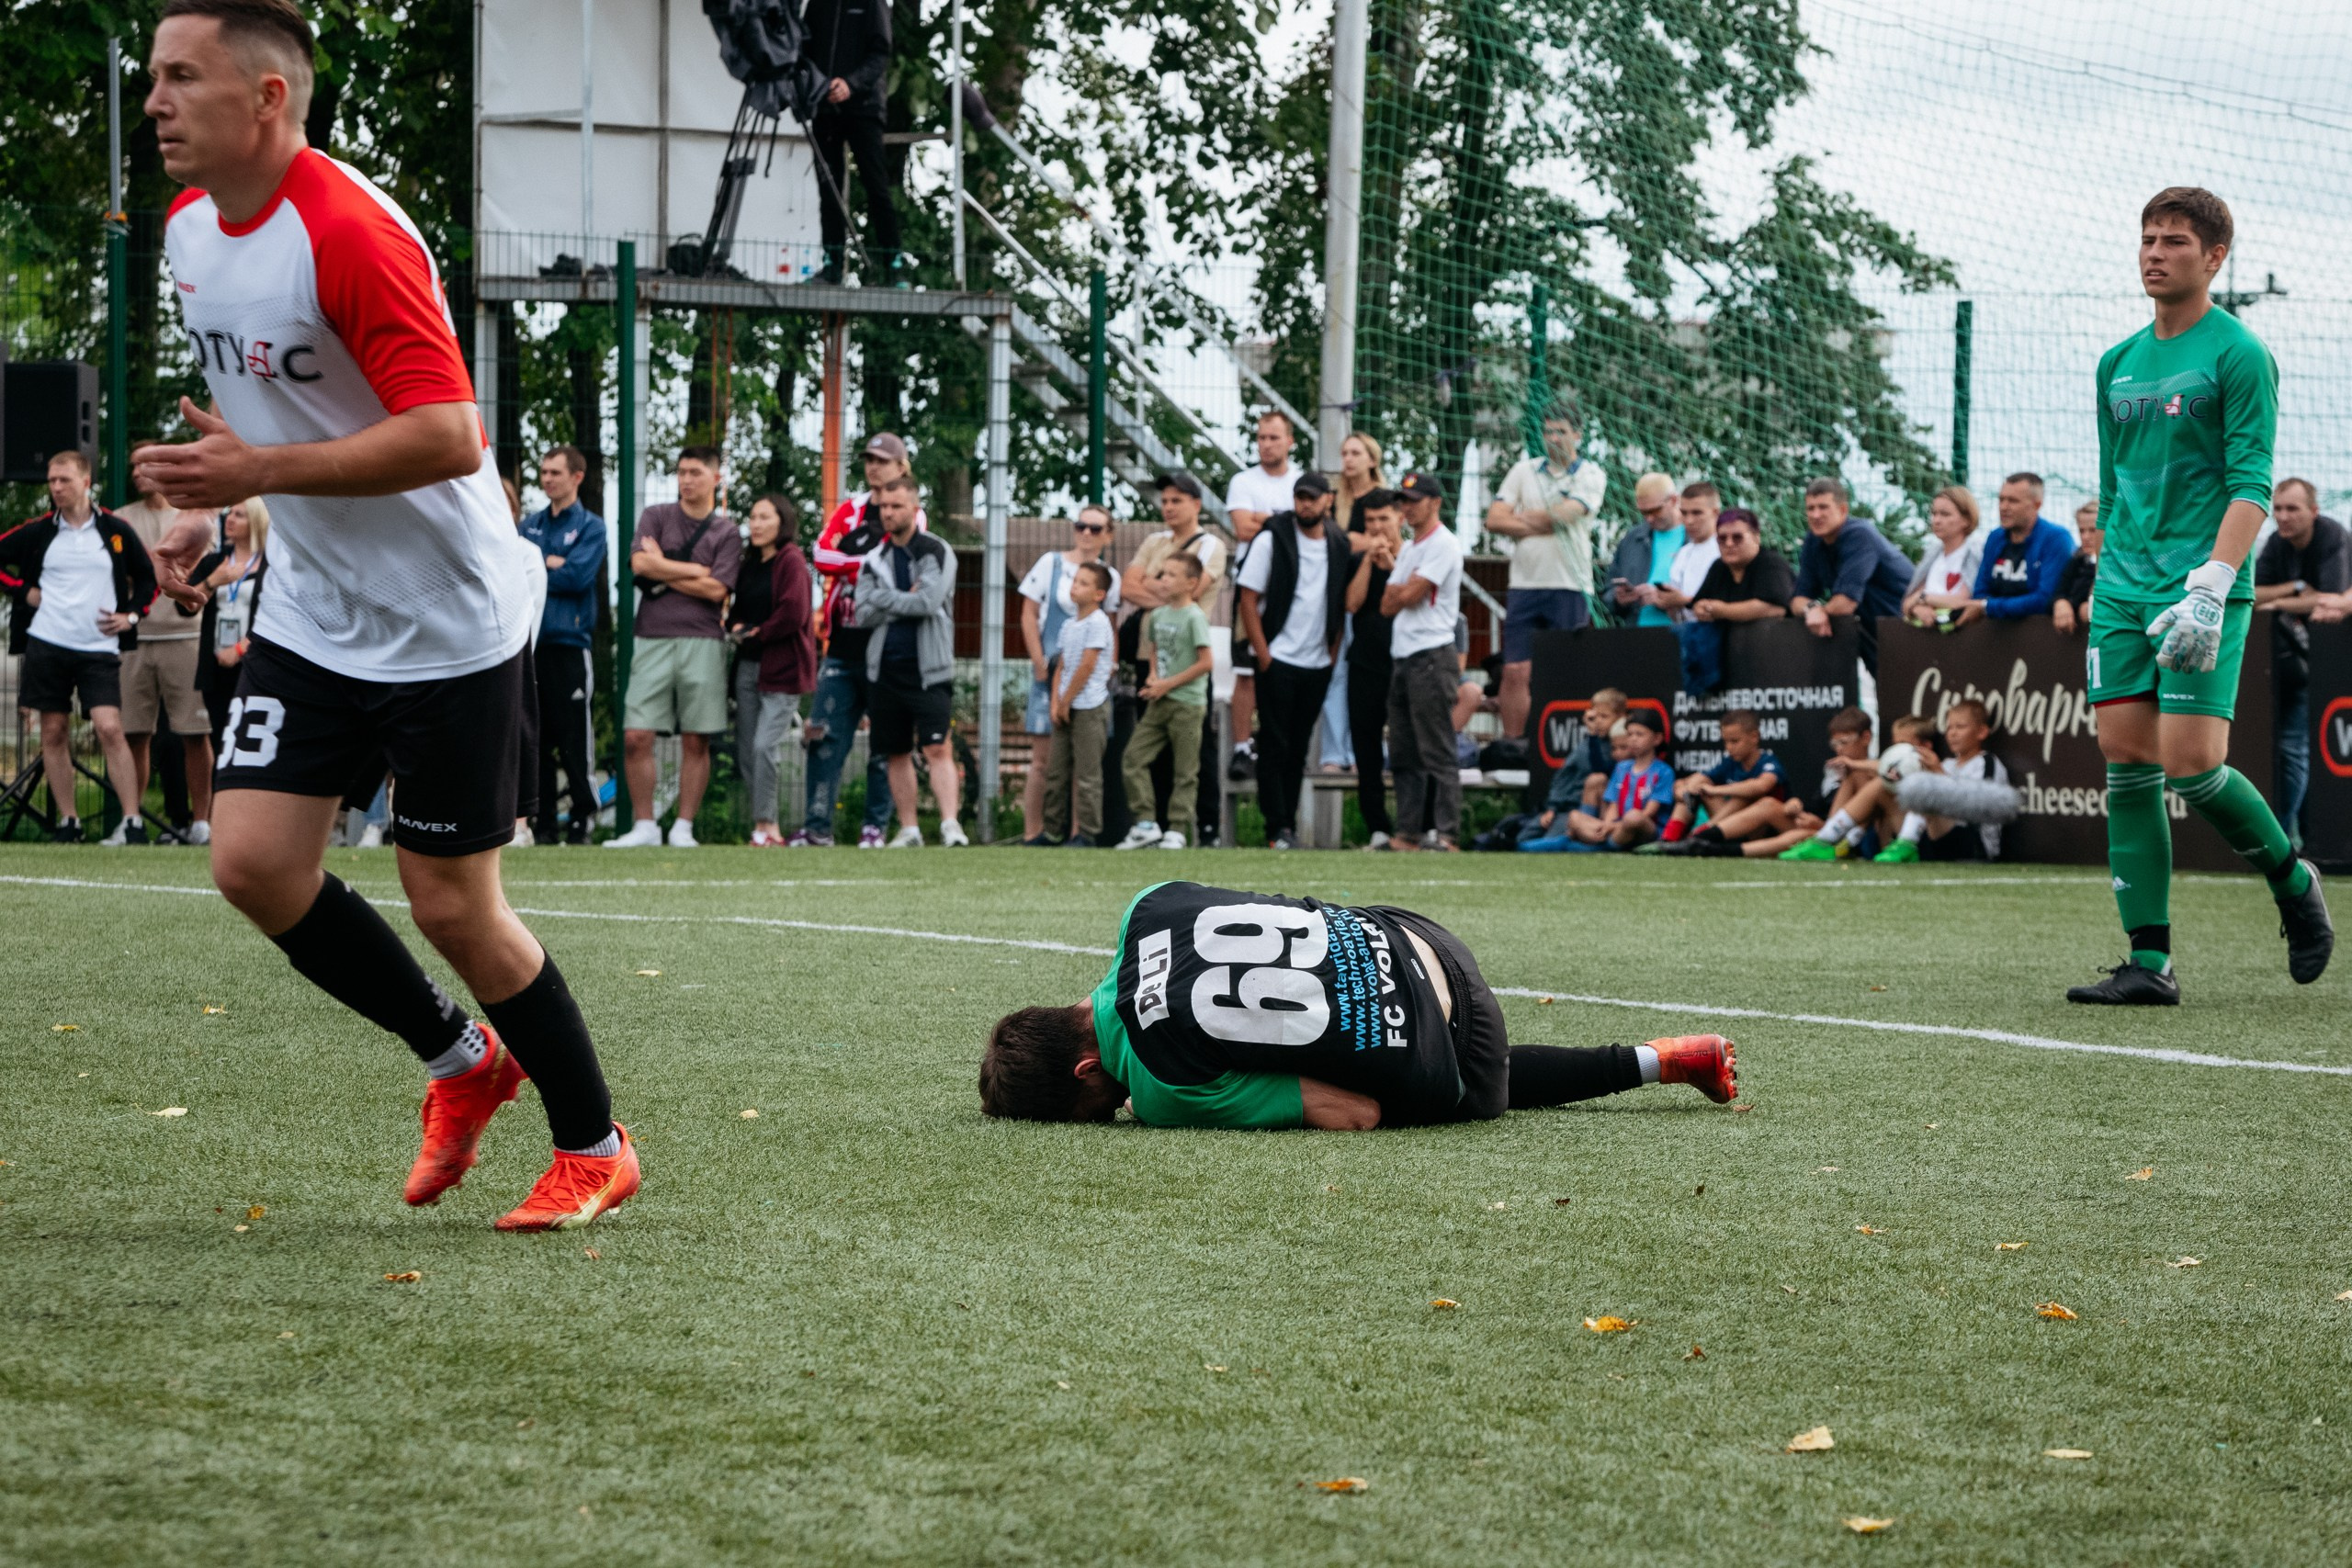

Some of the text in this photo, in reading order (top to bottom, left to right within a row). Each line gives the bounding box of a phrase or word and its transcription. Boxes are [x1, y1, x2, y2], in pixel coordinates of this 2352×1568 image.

[399, 815, 458, 832] MAVEX
[1192, 903, 1330, 1045] 69
[1323, 907, 1366, 1051] www.technoavia.ru
[1338, 909, 1381, 1048] www.volat-auto.ru
[1384, 1005, 1408, 1047] FC
